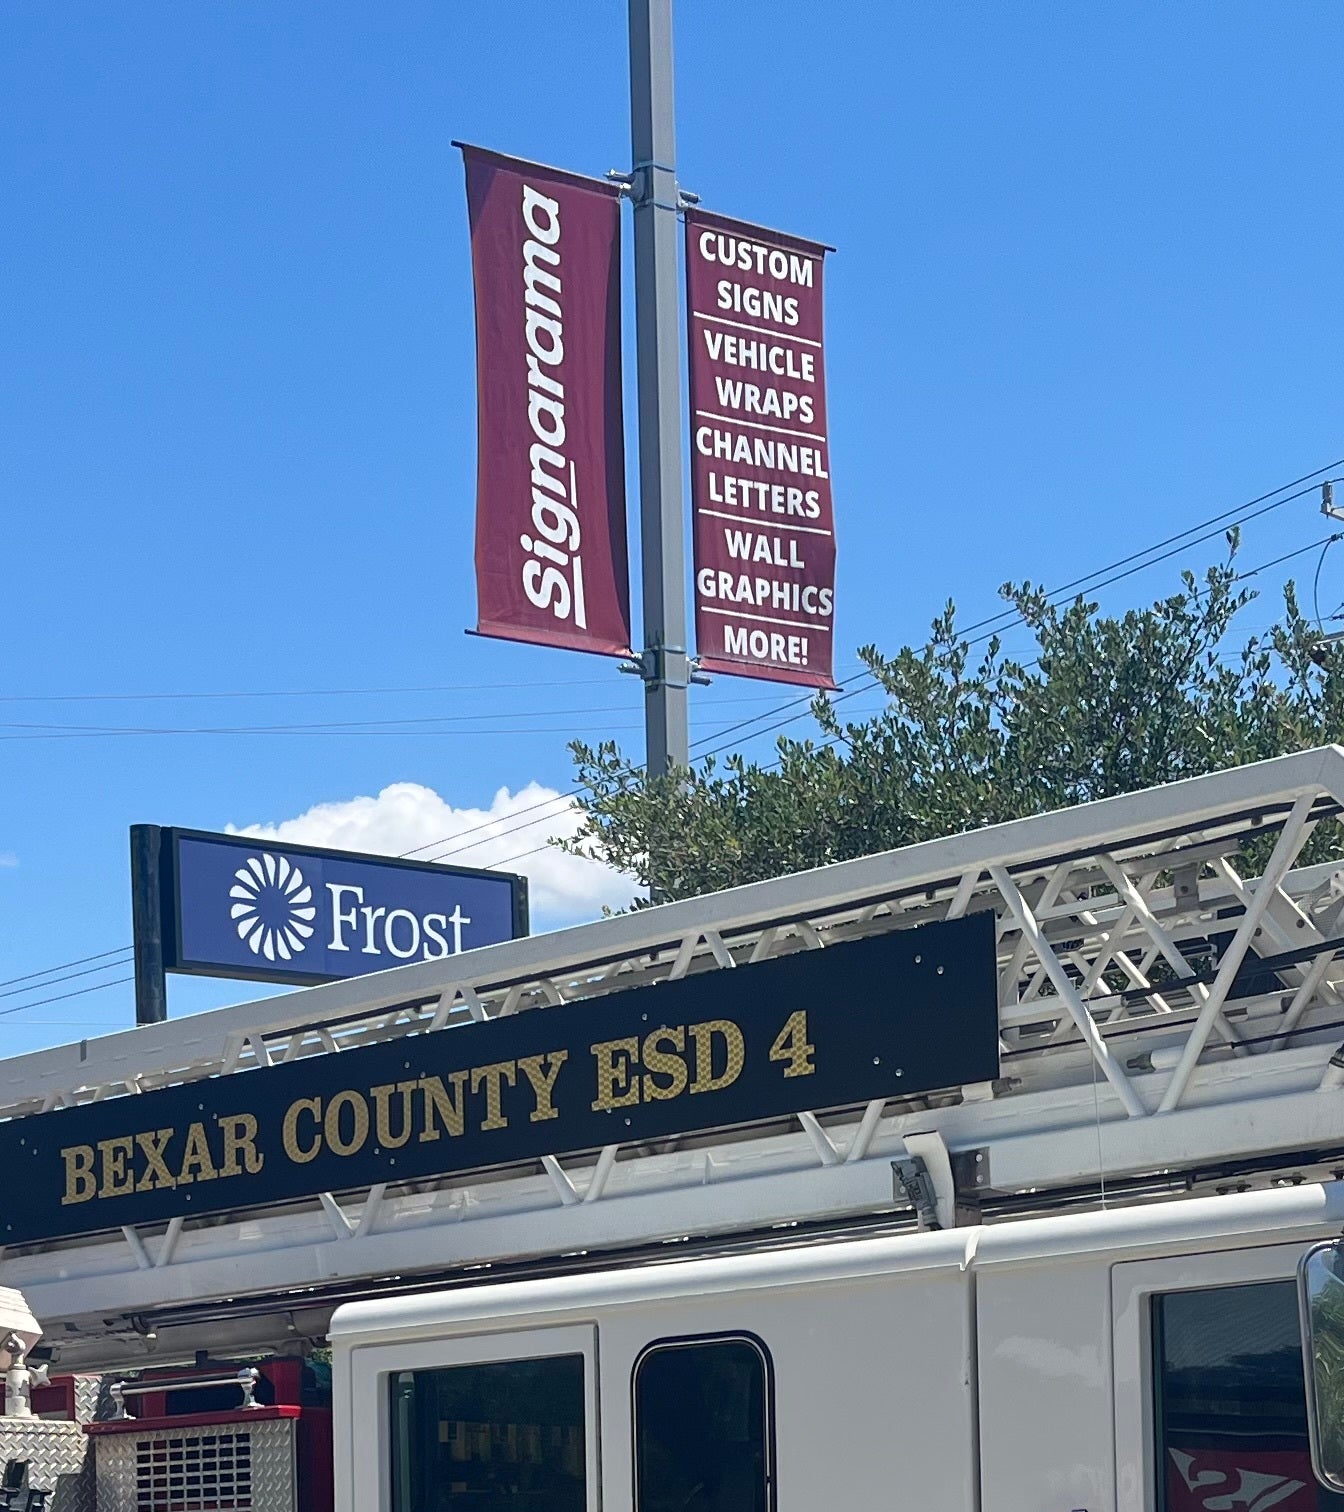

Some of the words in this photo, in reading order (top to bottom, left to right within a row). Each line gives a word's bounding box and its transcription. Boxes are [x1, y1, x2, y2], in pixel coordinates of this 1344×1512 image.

[699, 231, 814, 288] CUSTOM
[717, 280, 800, 326] SIGNS
[704, 329, 815, 383] VEHICLE
[522, 184, 582, 621] Signarama
[715, 376, 814, 424] WRAPS
[696, 426, 828, 479] CHANNEL
[708, 472, 821, 519] LETTERS
[724, 529, 805, 570] WALL
[697, 568, 834, 617] GRAPHICS
[724, 625, 809, 666] MORE!
[326, 882, 471, 961] Frost
[60, 1112, 265, 1206] BEXAR
[281, 1050, 569, 1165] COUNTY
[590, 1018, 748, 1112] ESD
[769, 1009, 817, 1079] 4
